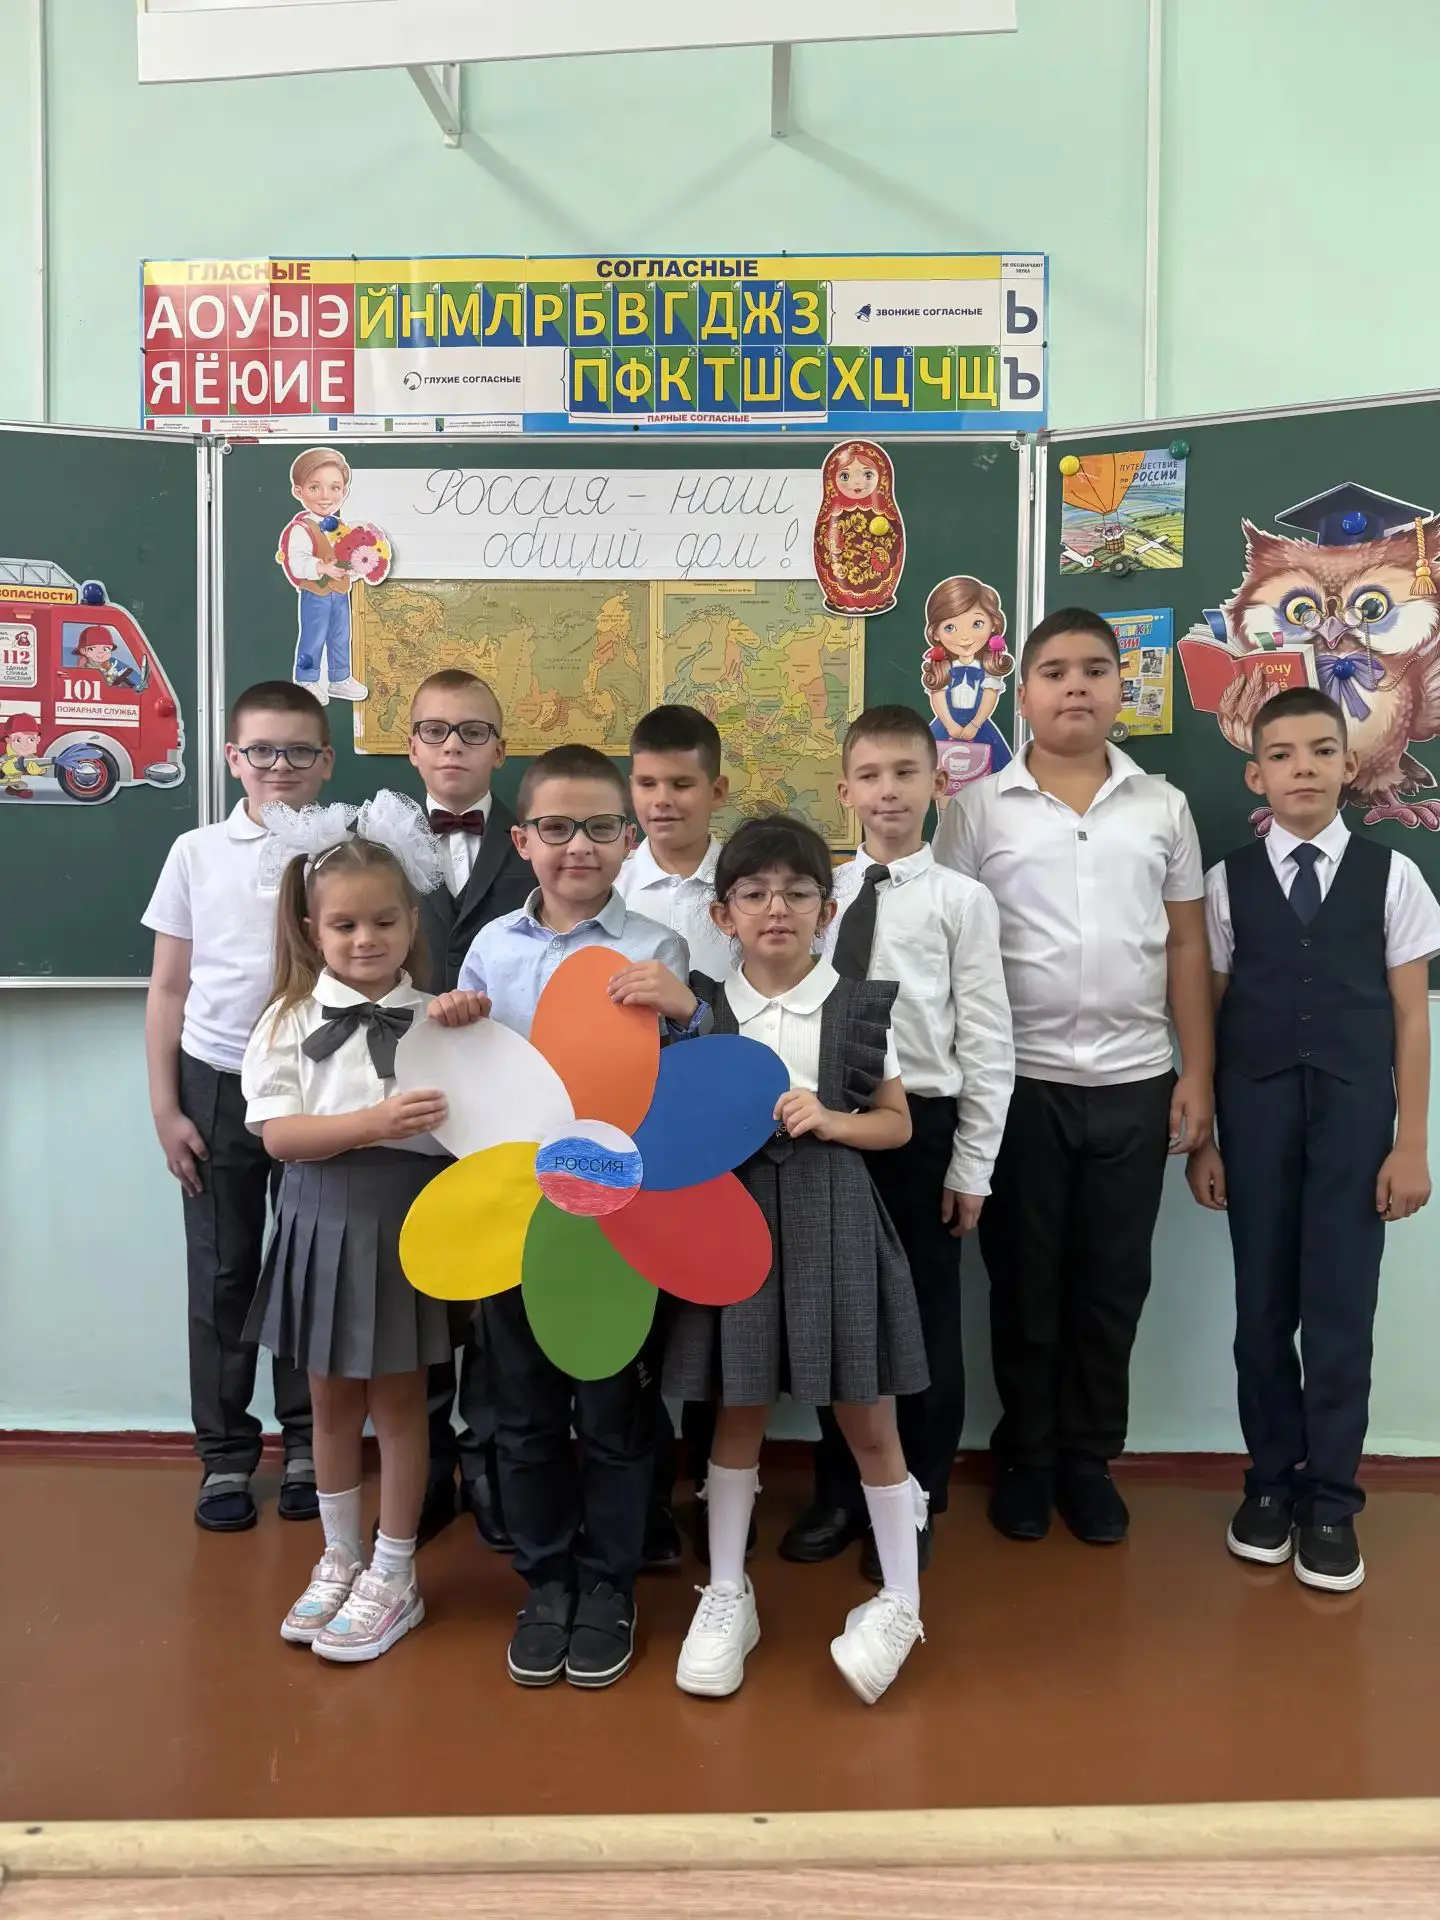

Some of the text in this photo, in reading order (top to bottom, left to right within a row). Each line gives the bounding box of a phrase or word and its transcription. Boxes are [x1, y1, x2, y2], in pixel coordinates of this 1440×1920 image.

[187, 262, 311, 281] ГЛАСНЫЕ
[596, 259, 759, 279] СОГЛАСНЫЕ
[875, 307, 983, 317] ЗВОНКИЕ СОГЛАСНЫЕ
[424, 375, 522, 384] ГЛУХИЕ СОГЛАСНЫЕ
[647, 414, 750, 423] ПАРНЫЕ СОГЛАСНЫЕ
[1119, 460, 1180, 472] ПУТЕШЕСТВИЕ
[1132, 469, 1178, 482] РОССИИ
[413, 468, 616, 516] Россия
[669, 475, 795, 515] наш
[483, 516, 649, 576] общий
[0, 588, 74, 602] ОПАСНОСТИ
[2, 649, 31, 665] 112
[63, 679, 102, 701] 101
[56, 705, 138, 717] ПОЖАРНАЯ СЛУЖБА
[554, 1156, 624, 1173] РОССИЯ
